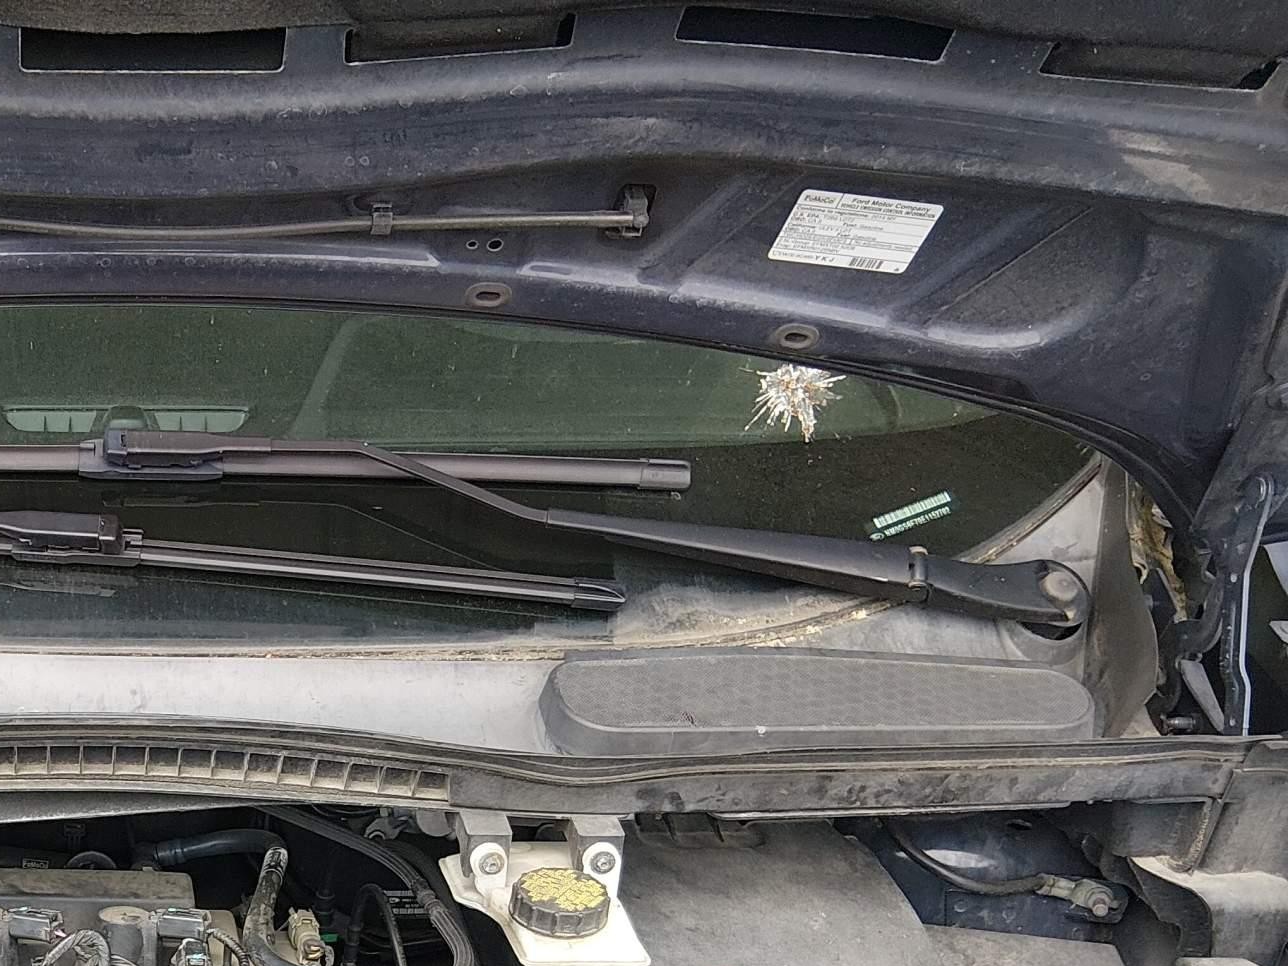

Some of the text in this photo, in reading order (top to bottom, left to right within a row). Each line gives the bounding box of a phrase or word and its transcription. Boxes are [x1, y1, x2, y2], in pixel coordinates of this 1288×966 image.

[851, 198, 931, 213] Ford Motor Company
